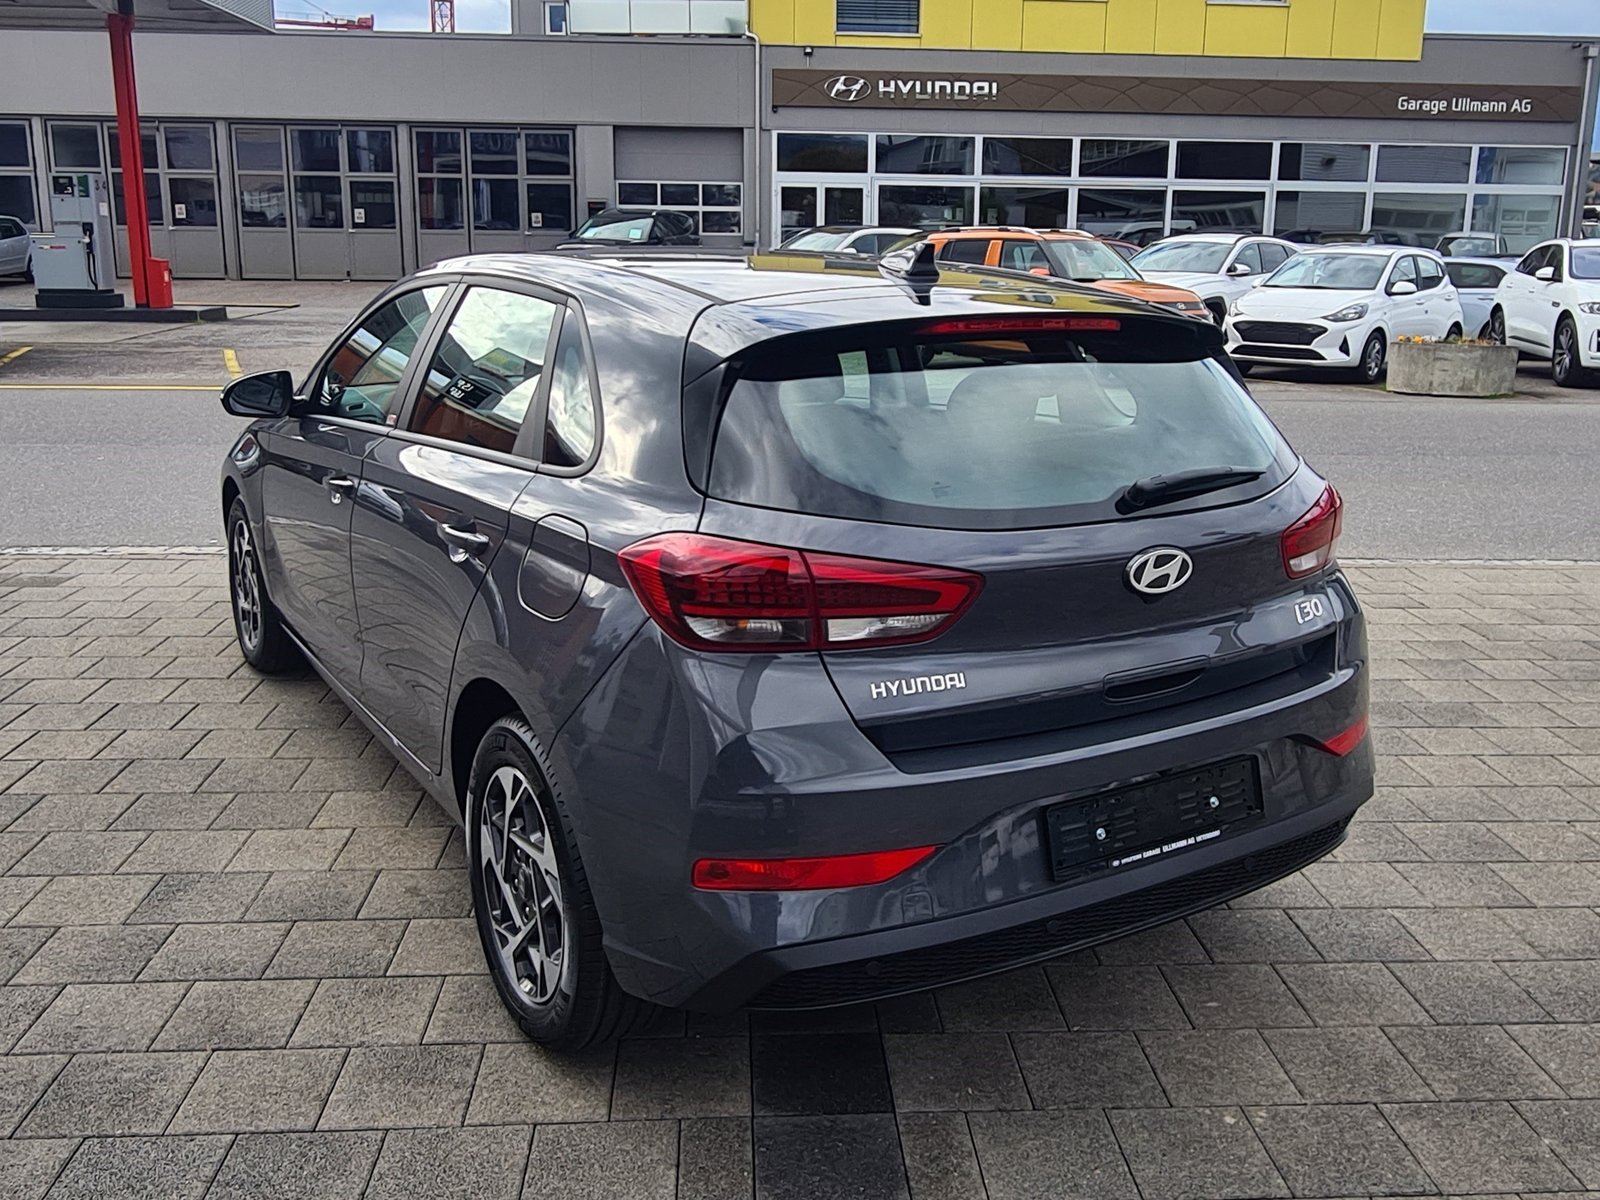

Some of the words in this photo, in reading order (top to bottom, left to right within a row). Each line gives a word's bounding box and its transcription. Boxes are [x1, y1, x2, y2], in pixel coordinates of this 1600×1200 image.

[878, 79, 998, 100] HYUNDAI
[1398, 96, 1447, 114] Garage
[1452, 97, 1507, 112] Ullmann
[1511, 99, 1532, 113] AG
[870, 672, 966, 699] HYUNDAI
